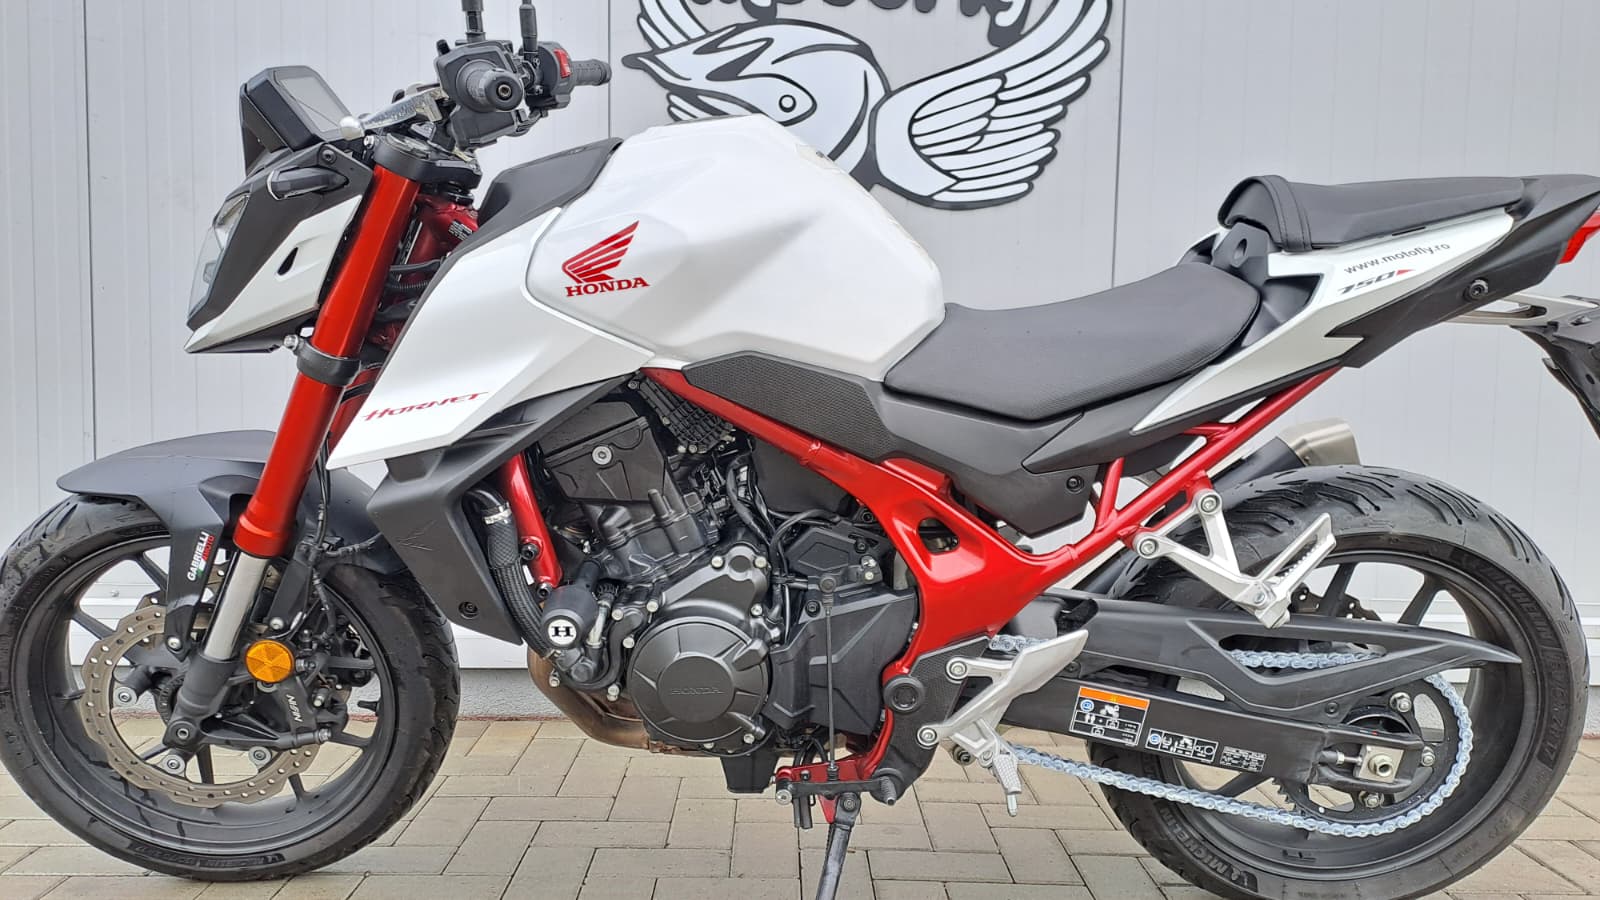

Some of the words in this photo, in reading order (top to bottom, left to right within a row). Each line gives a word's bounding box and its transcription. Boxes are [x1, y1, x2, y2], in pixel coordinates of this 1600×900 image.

[1344, 243, 1451, 274] www.motofly.ro
[565, 276, 650, 297] HONDA
[1337, 270, 1396, 295] 750
[363, 392, 488, 421] HORNET
[186, 531, 210, 581] GABRIELLI
[551, 626, 574, 637] H
[1160, 806, 1228, 876] MICHELIN
